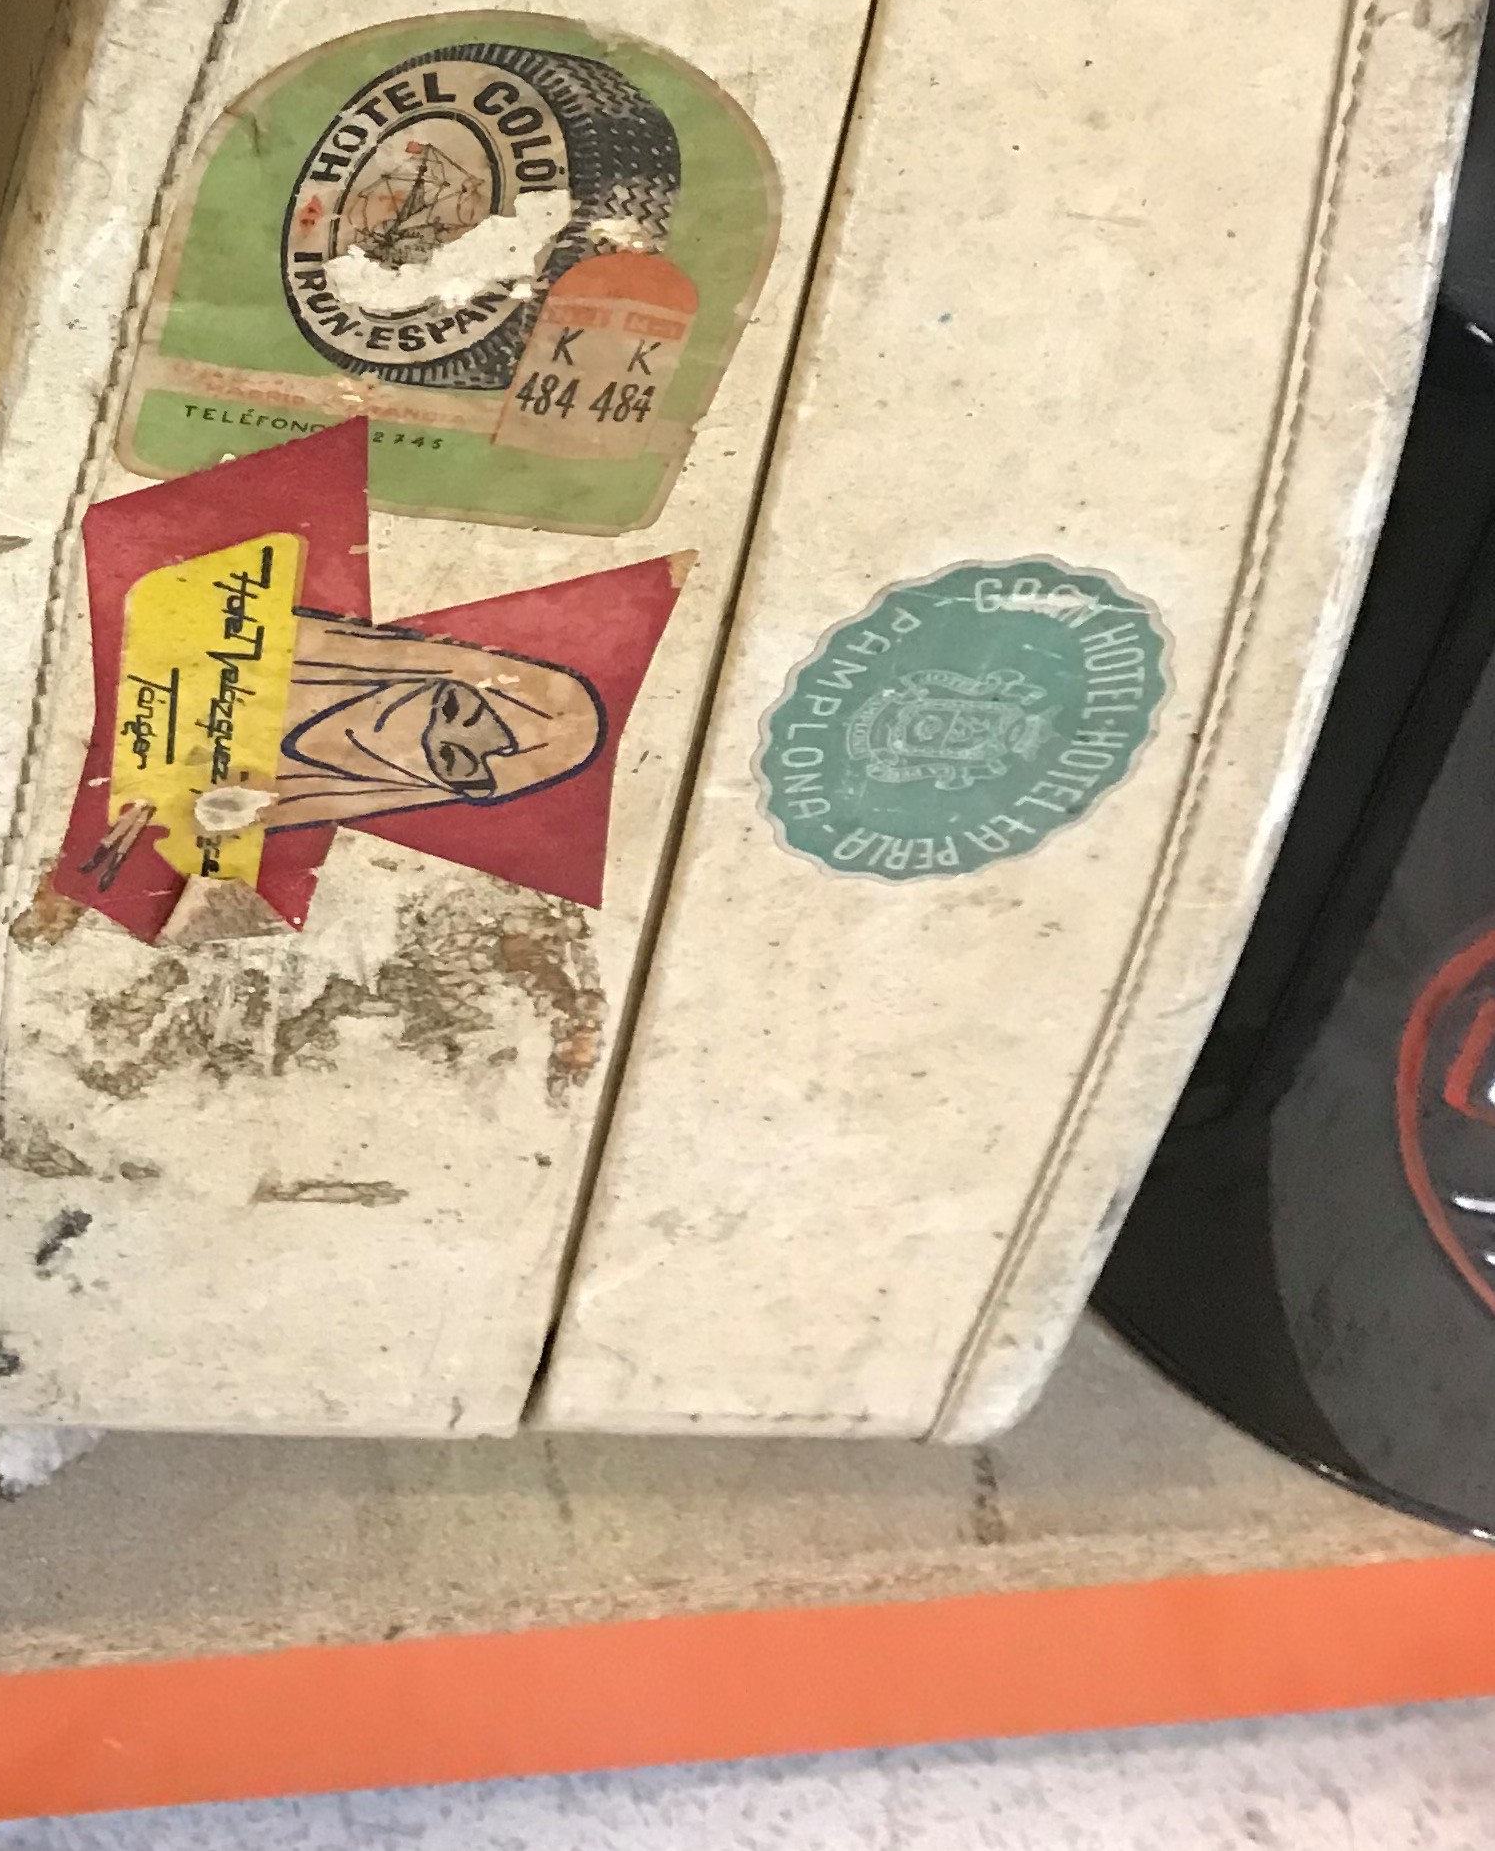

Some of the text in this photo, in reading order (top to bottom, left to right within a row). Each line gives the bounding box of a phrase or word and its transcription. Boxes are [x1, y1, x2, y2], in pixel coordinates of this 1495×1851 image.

[310, 71, 457, 184] HOTEL
[551, 325, 662, 376] K K
[514, 370, 656, 423] 484 484
[213, 546, 274, 639] Hotel
[780, 606, 923, 821] PAMPLONA
[1079, 621, 1146, 720] HOTEL
[1013, 729, 1130, 814] HOTEL
[832, 827, 960, 870] PERLA
